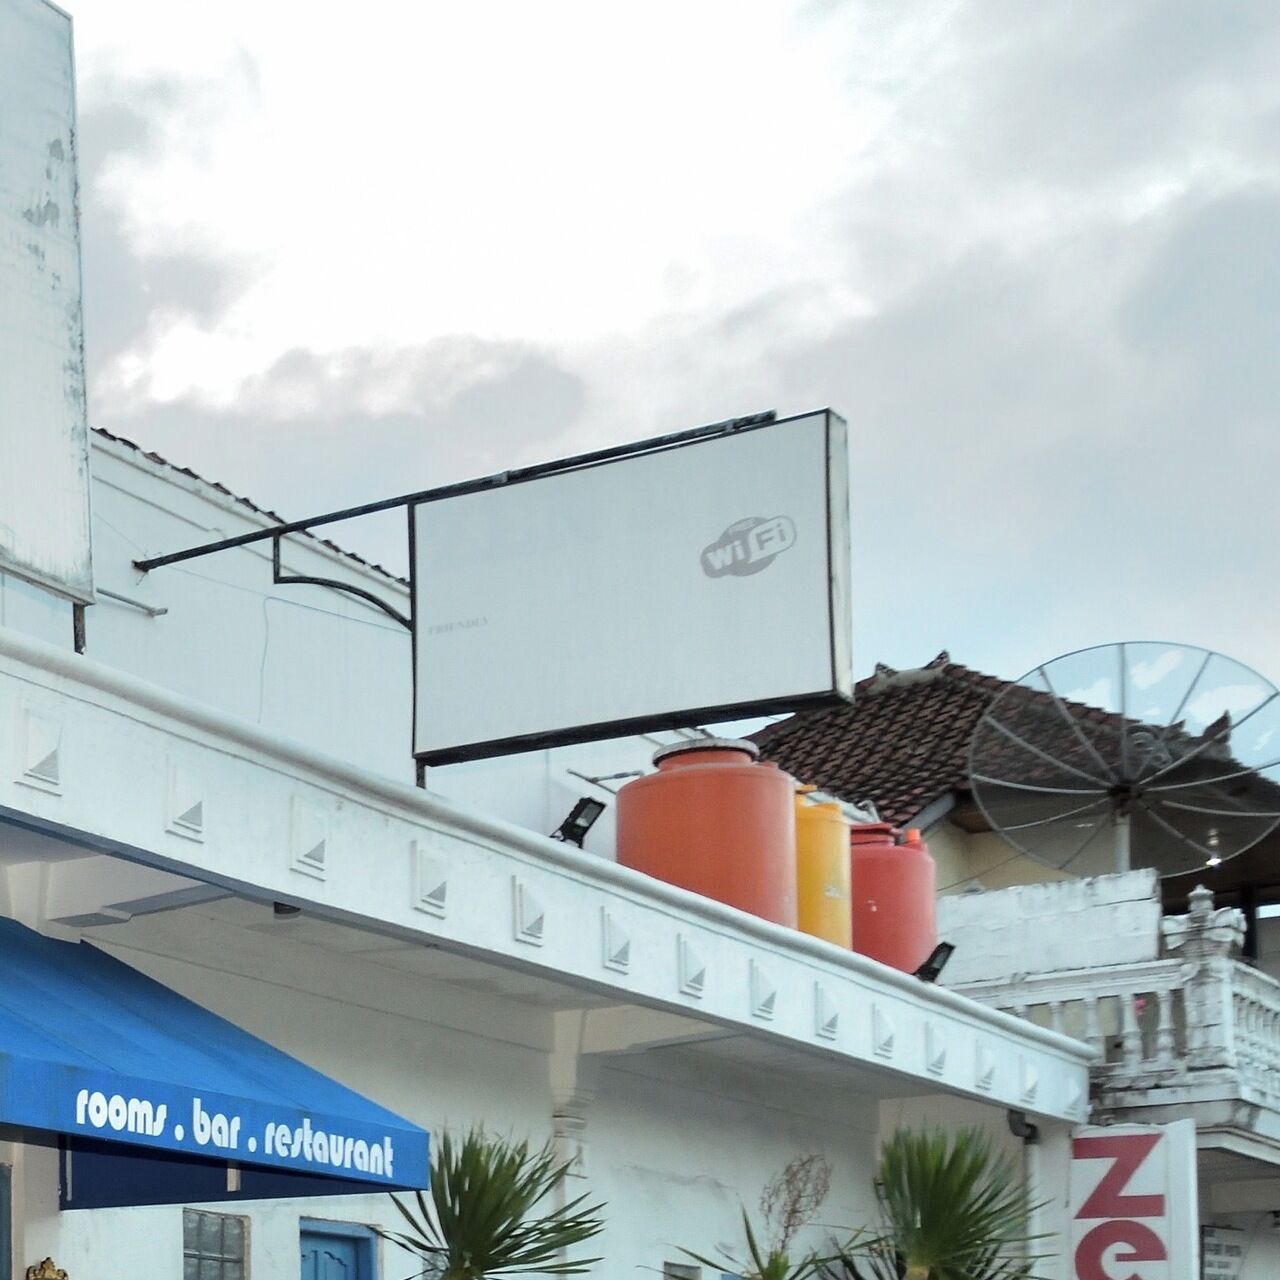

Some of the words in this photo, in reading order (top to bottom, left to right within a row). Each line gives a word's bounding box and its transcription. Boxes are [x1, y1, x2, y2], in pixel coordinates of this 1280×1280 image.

[75, 1088, 168, 1138] rooms
[192, 1097, 242, 1150] bar
[264, 1117, 394, 1179] restaurant
